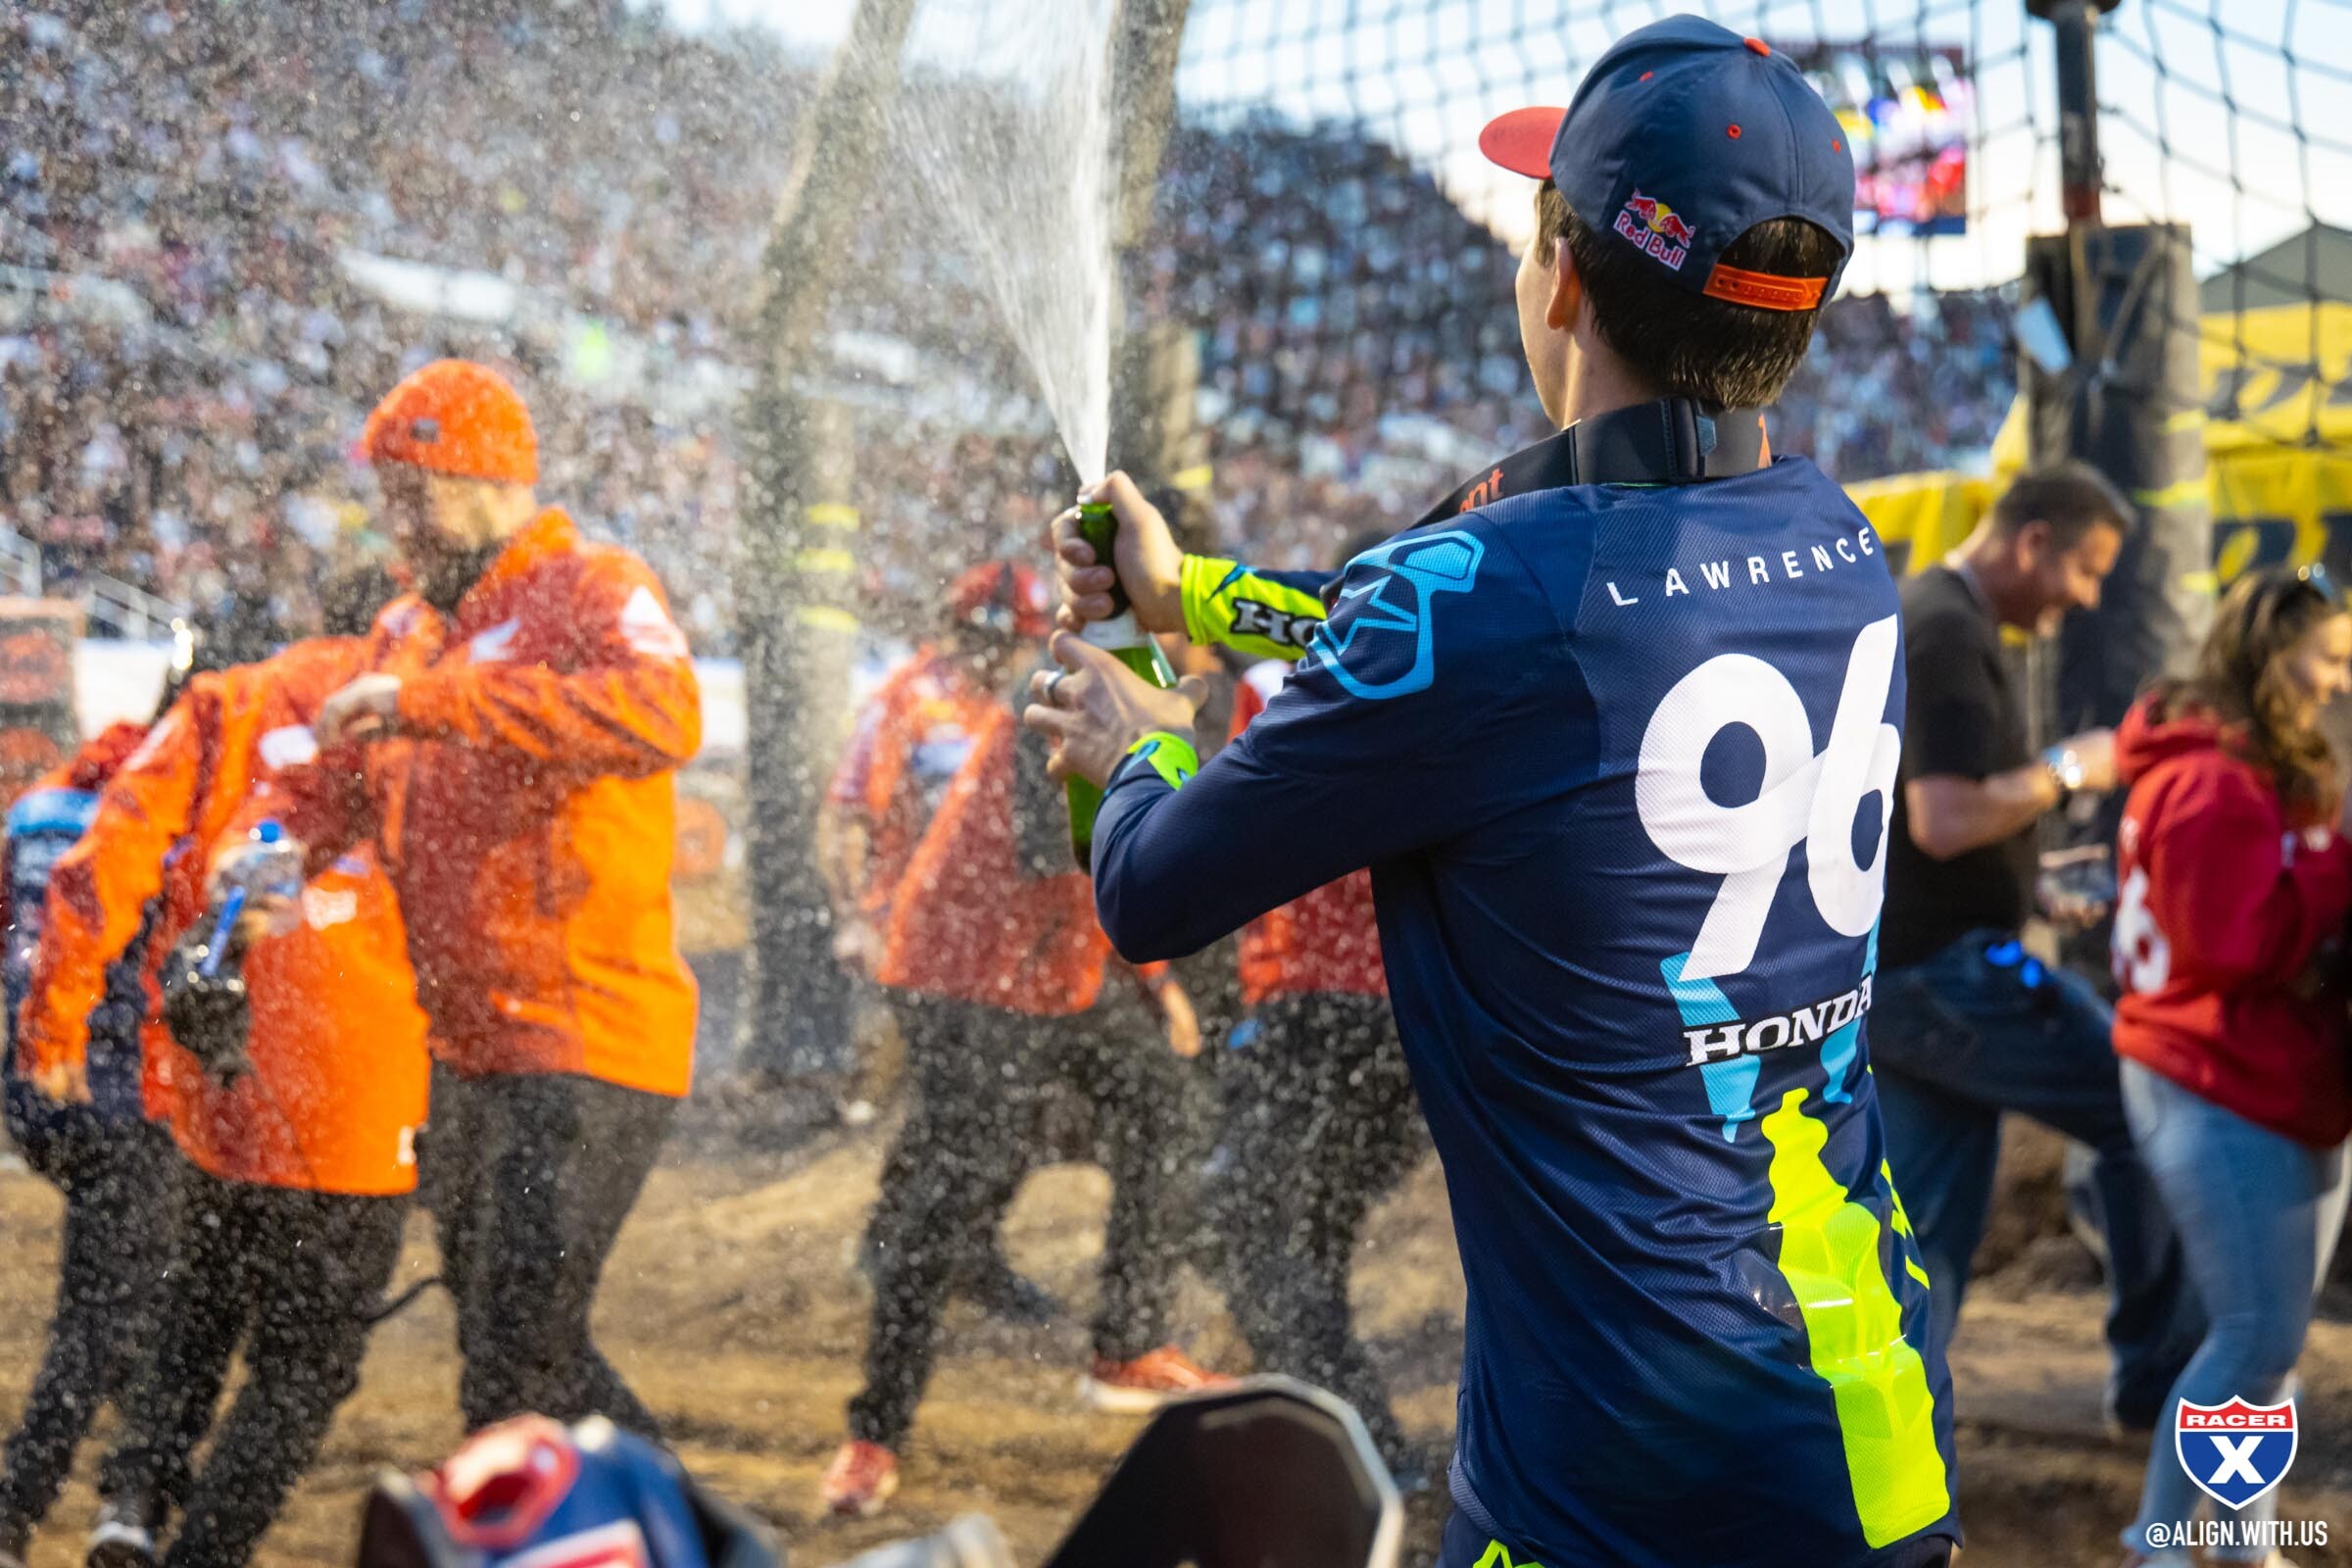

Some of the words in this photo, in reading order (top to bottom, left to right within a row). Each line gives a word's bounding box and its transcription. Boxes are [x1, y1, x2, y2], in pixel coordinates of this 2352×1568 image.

[1614, 211, 1647, 249] Red
[1644, 234, 1687, 271] Bull
[1607, 527, 1873, 606] LAWRENCE
[1635, 613, 1901, 981] 96
[1683, 975, 1873, 1067] HONDA
